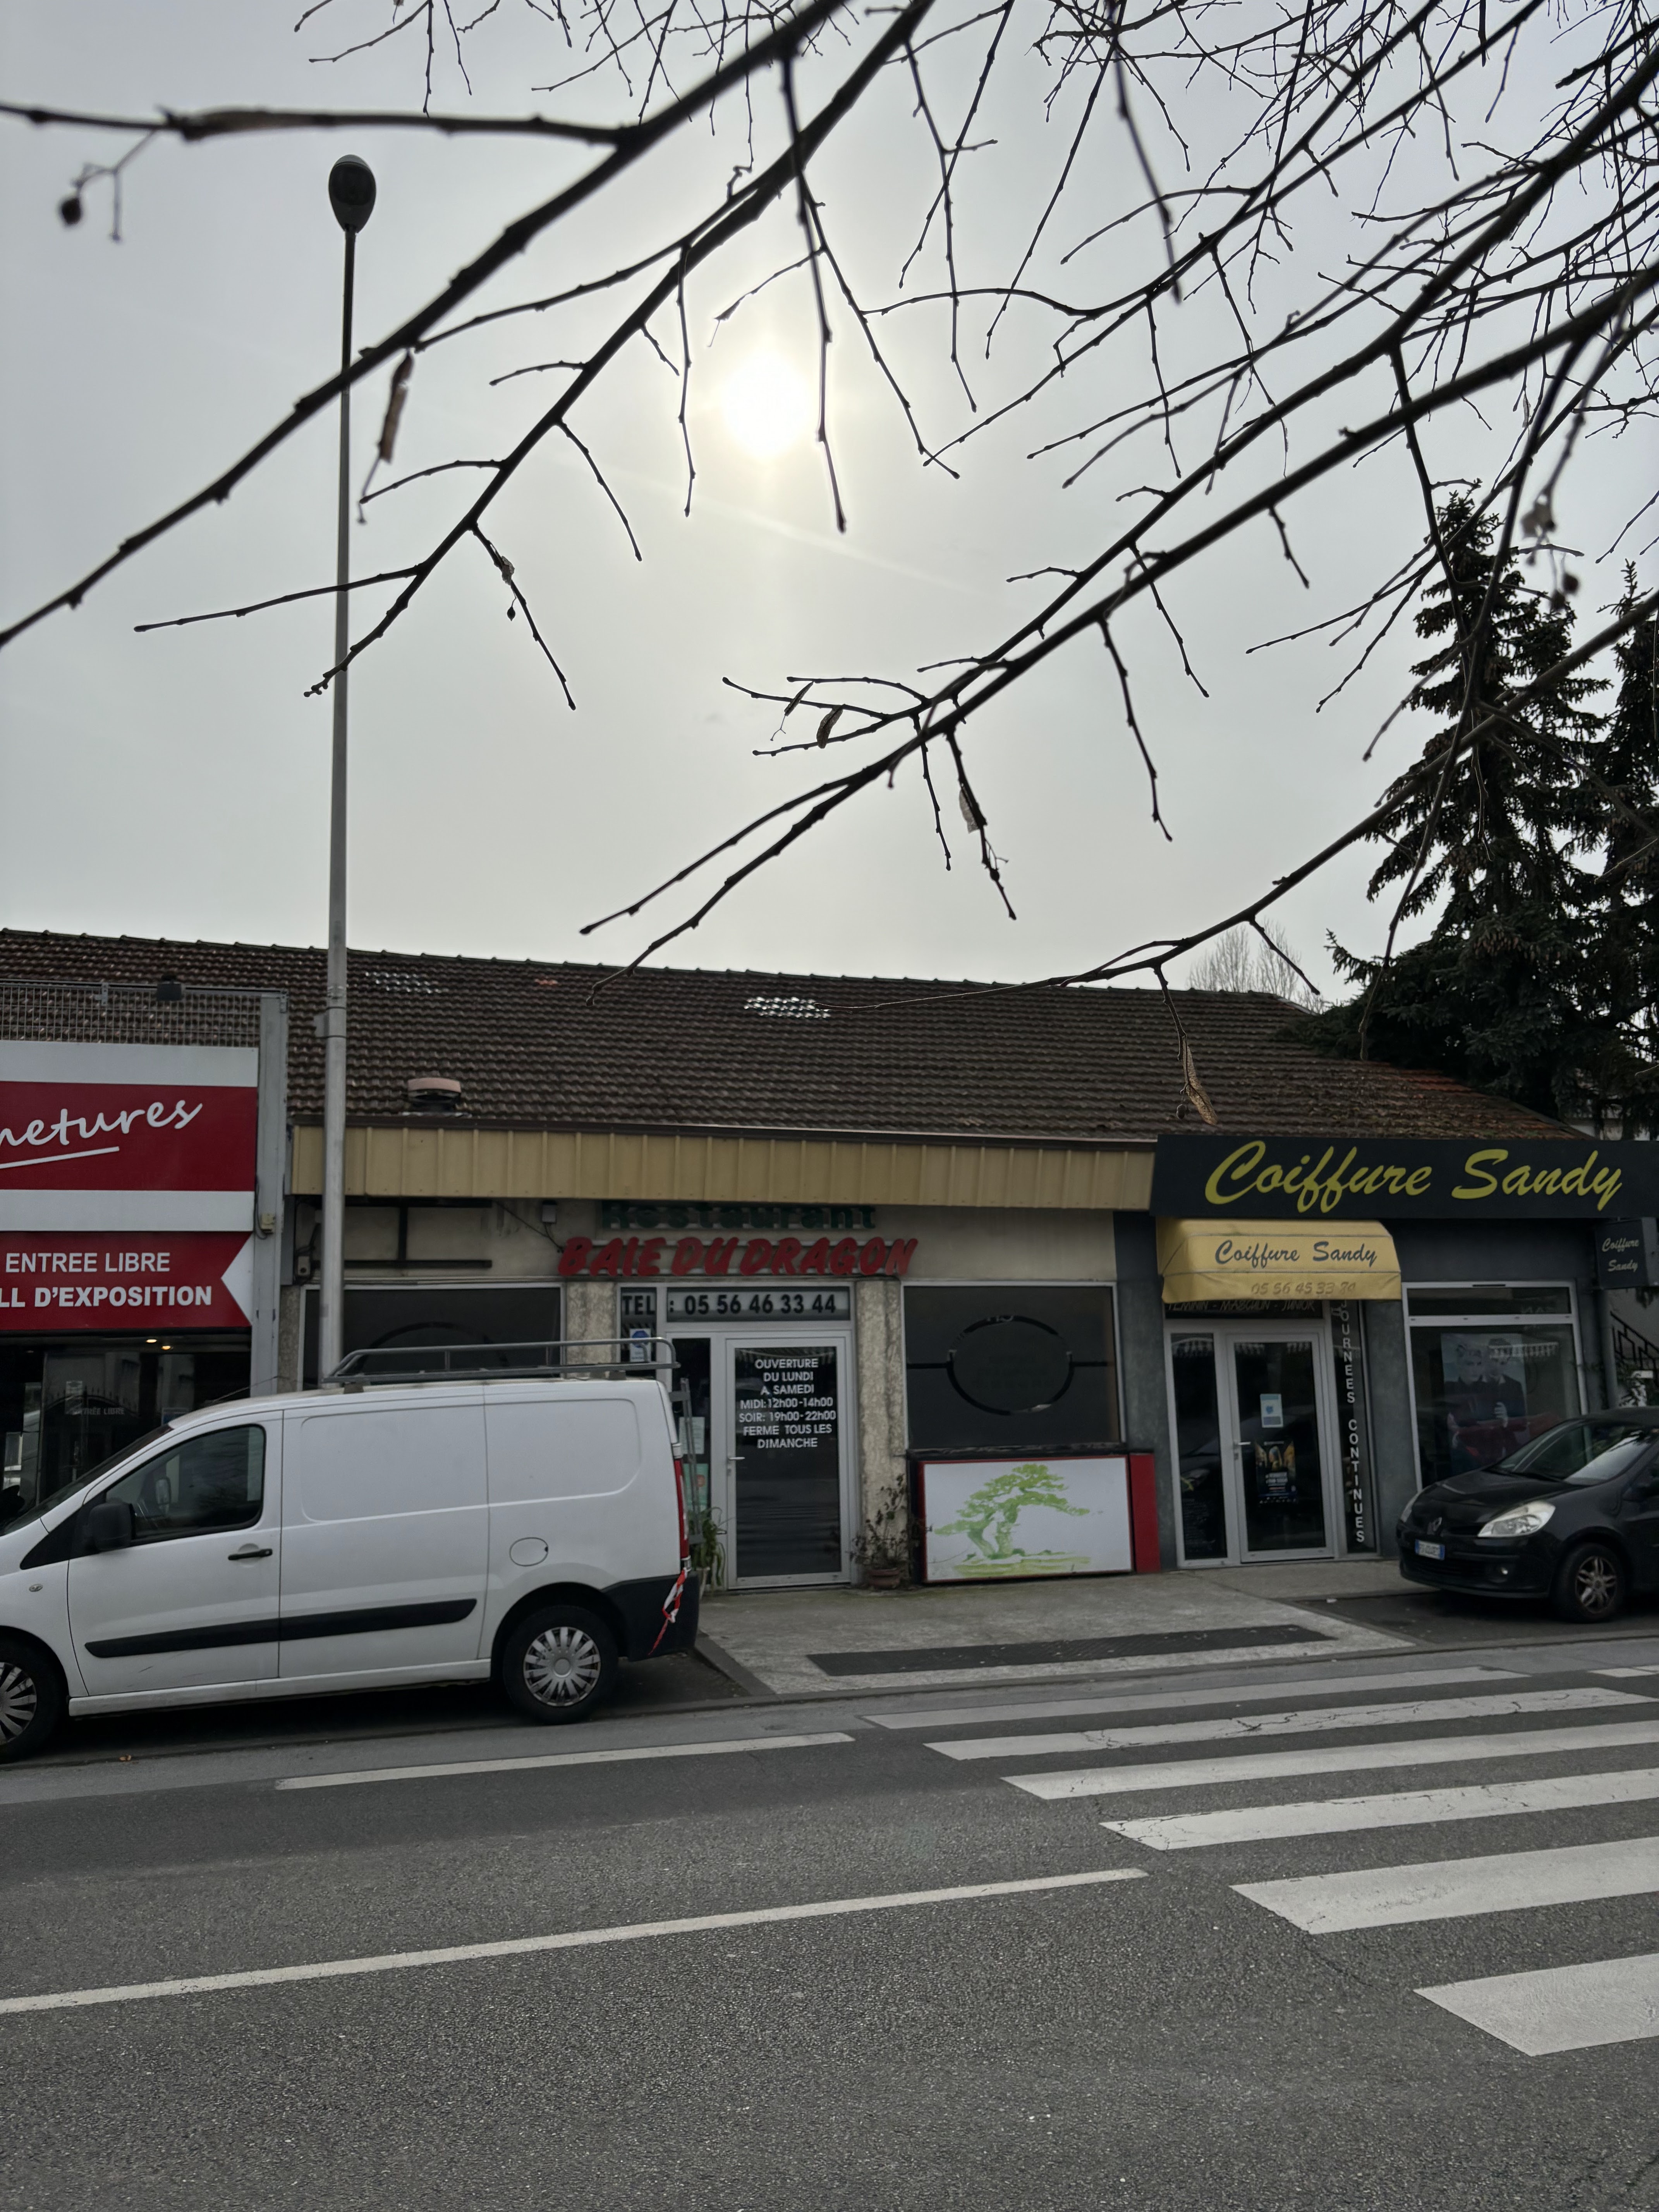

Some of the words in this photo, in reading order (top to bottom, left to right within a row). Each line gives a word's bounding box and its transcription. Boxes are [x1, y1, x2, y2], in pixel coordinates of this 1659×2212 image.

[1205, 1140, 1432, 1213] Coiffure
[1451, 1149, 1622, 1211] Sandy
[602, 1200, 876, 1229] Restaurant
[1602, 1237, 1640, 1252] Coiffure
[5, 1253, 98, 1273] ENTREE
[105, 1252, 170, 1272] LIBRE
[558, 1237, 666, 1276] BAIE
[672, 1237, 739, 1276] DU
[740, 1237, 918, 1276] DRAGON
[1215, 1240, 1300, 1268] Coiffure
[1312, 1241, 1377, 1267] Sandy
[1607, 1259, 1638, 1273] Sandy
[34, 1286, 212, 1307] D'EXPOSITION
[622, 1295, 656, 1316] TEL
[685, 1295, 709, 1315] 05
[717, 1295, 741, 1314] 56
[749, 1295, 773, 1314] 46
[781, 1294, 804, 1314] 33
[812, 1294, 836, 1313] 44
[754, 1358, 819, 1369] OUVERTURE
[763, 1372, 779, 1382] DU
[781, 1371, 814, 1381] LUNDI
[773, 1384, 814, 1394] SAMEDI
[739, 1413, 765, 1422] SOIR:
[743, 1425, 780, 1436] FERME
[785, 1424, 812, 1435] TOUS
[813, 1424, 832, 1434] LES
[757, 1437, 818, 1449] DIMANCHE
[1348, 1419, 1365, 1543] CONTINUES
